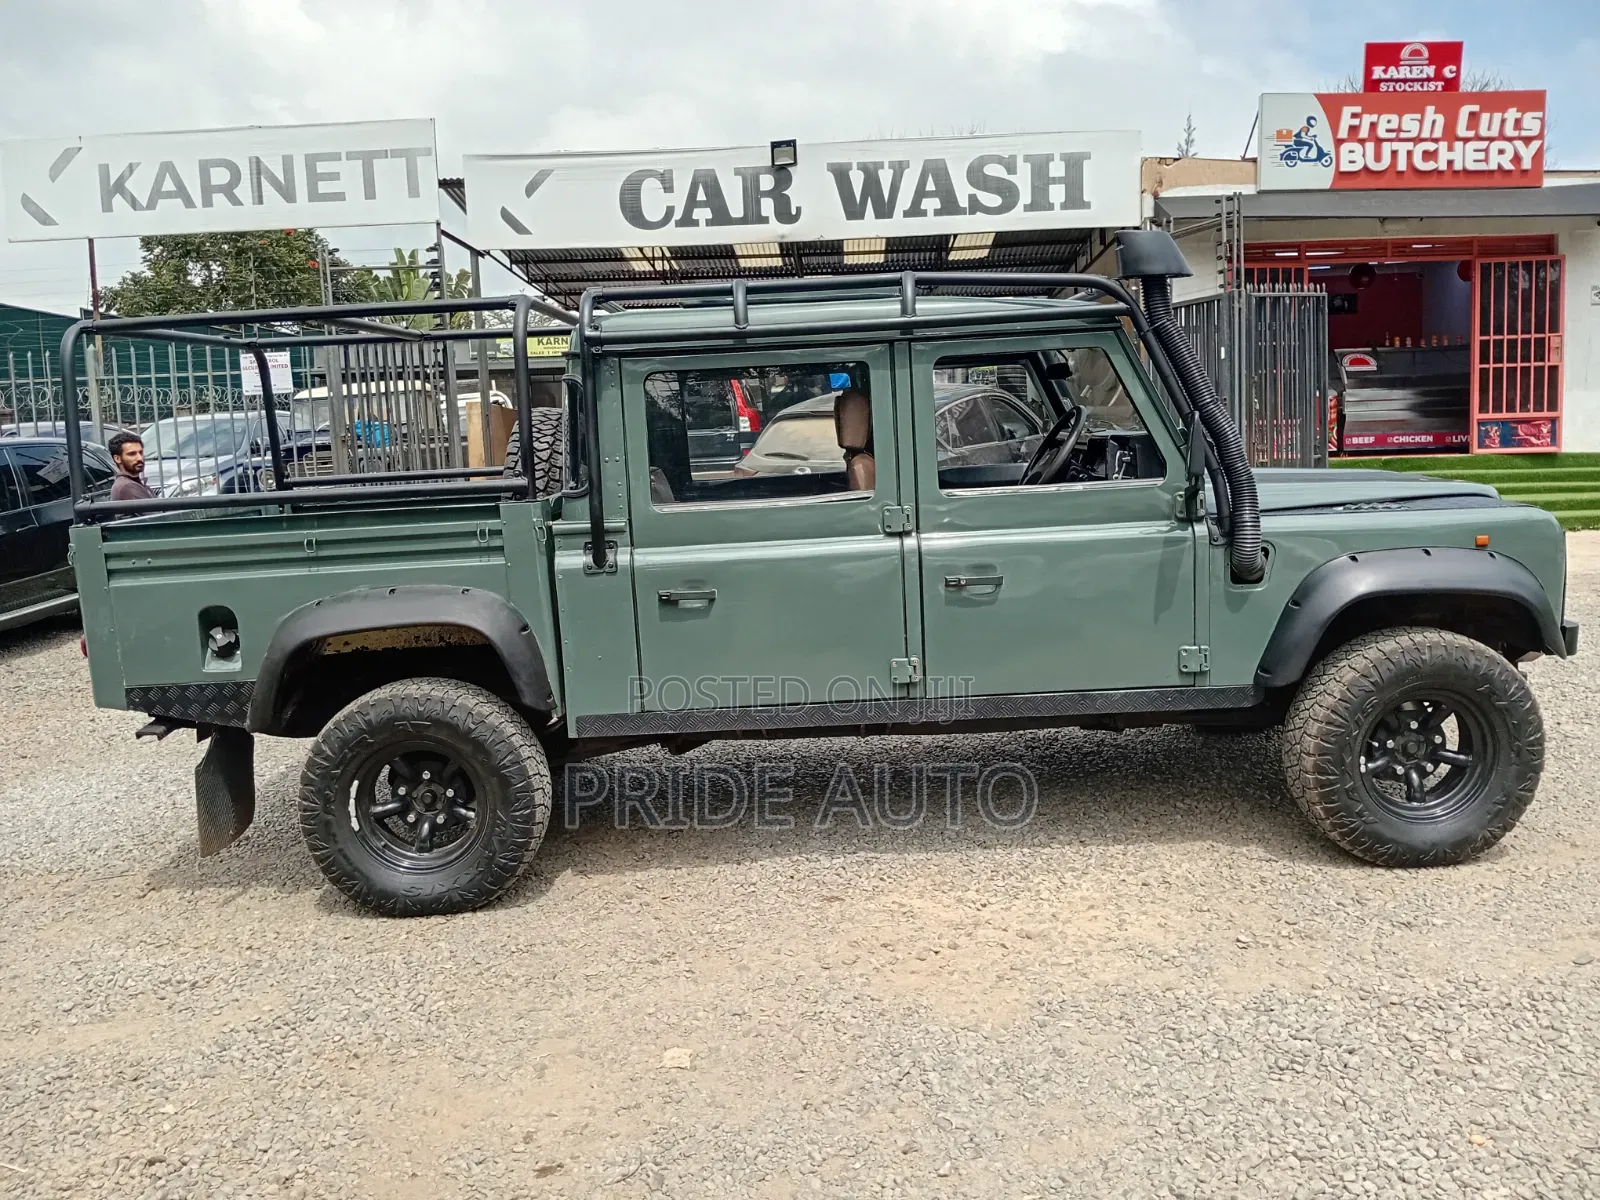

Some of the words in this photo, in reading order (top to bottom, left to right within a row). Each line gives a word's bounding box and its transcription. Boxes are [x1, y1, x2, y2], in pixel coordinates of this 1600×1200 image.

[1371, 65, 1436, 80] KAREN
[1442, 65, 1457, 79] C
[1379, 81, 1445, 92] STOCKIST
[1336, 105, 1445, 140] Fresh
[1455, 104, 1543, 138] Cuts
[1338, 140, 1543, 173] BUTCHERY
[98, 147, 433, 213] KARNETT
[618, 165, 802, 231] CAR
[826, 151, 1092, 221] WASH
[537, 337, 569, 346] KARN
[1352, 436, 1375, 445] BEEF
[1393, 435, 1433, 443] CHICKEN
